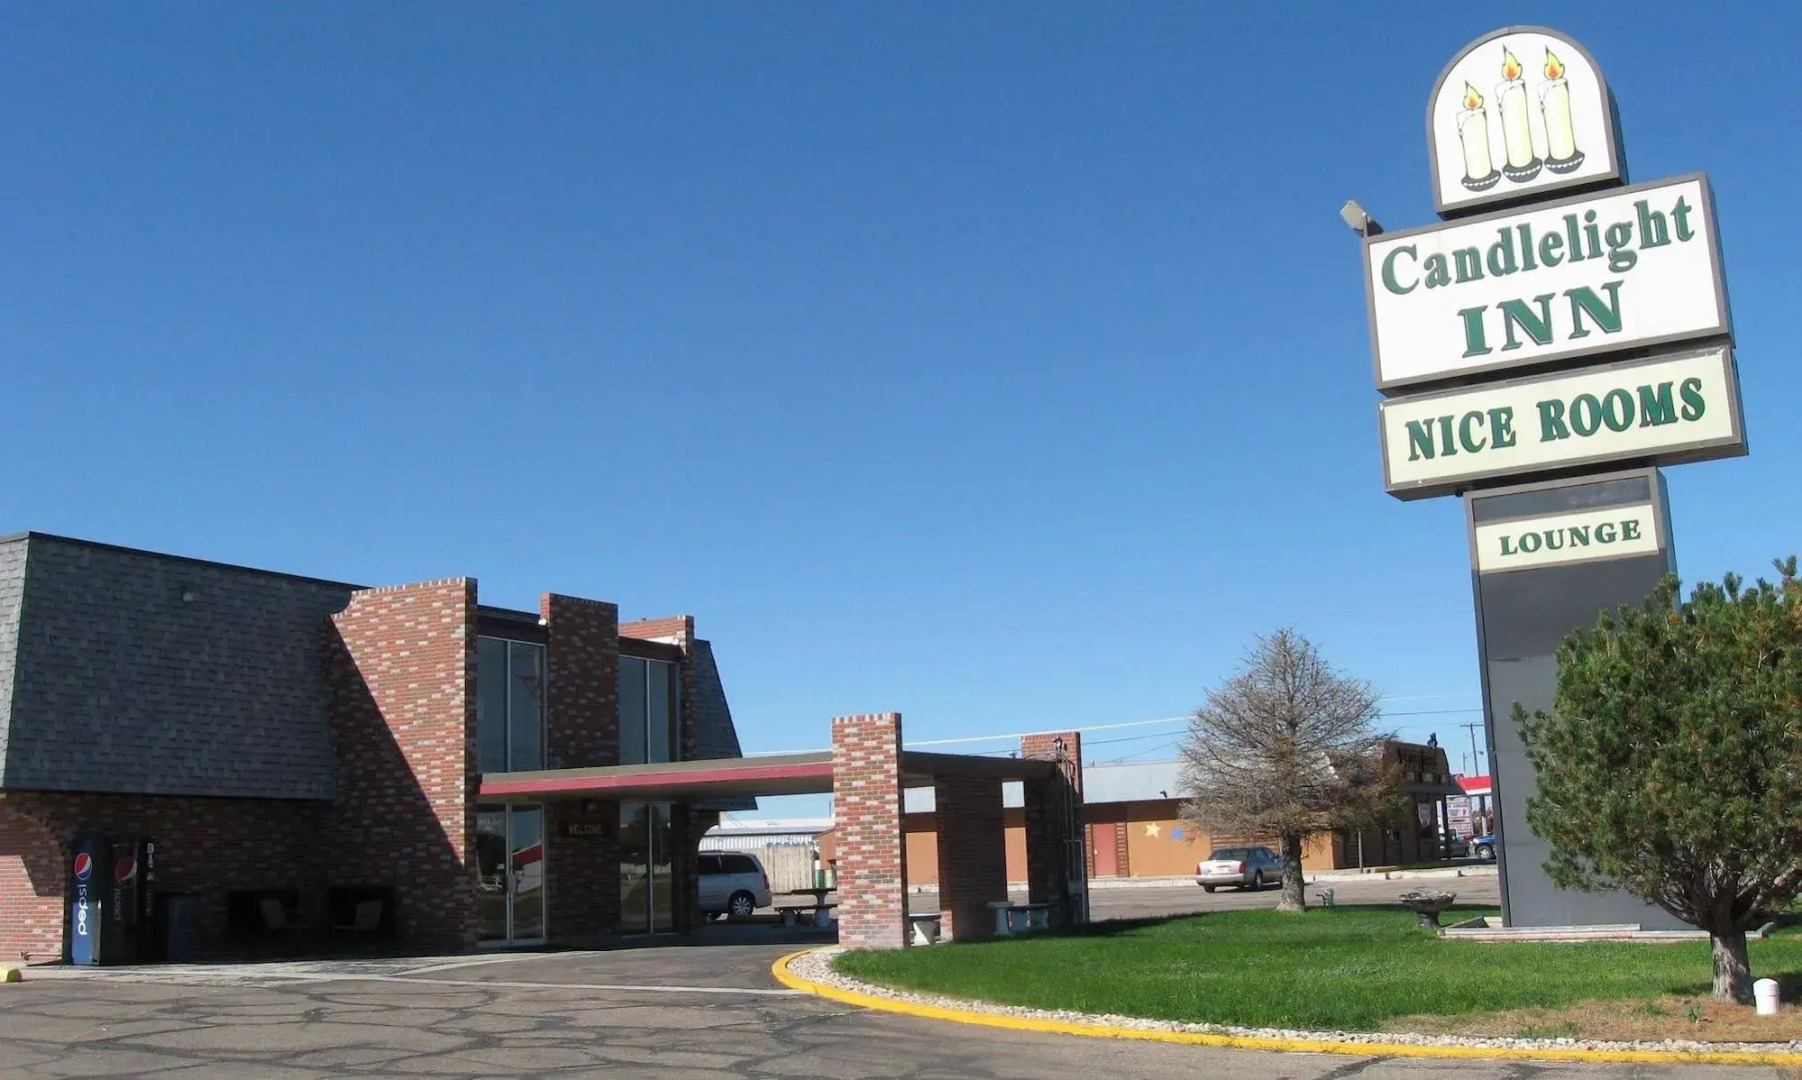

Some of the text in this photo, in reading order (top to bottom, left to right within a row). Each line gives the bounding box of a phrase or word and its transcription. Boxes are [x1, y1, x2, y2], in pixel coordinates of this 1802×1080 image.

[1381, 195, 1695, 295] Candlelight
[1457, 280, 1625, 358] INN
[1405, 377, 1706, 462] NICE ROOMS
[1498, 519, 1642, 556] LOUNGE
[77, 883, 88, 935] pepsi
